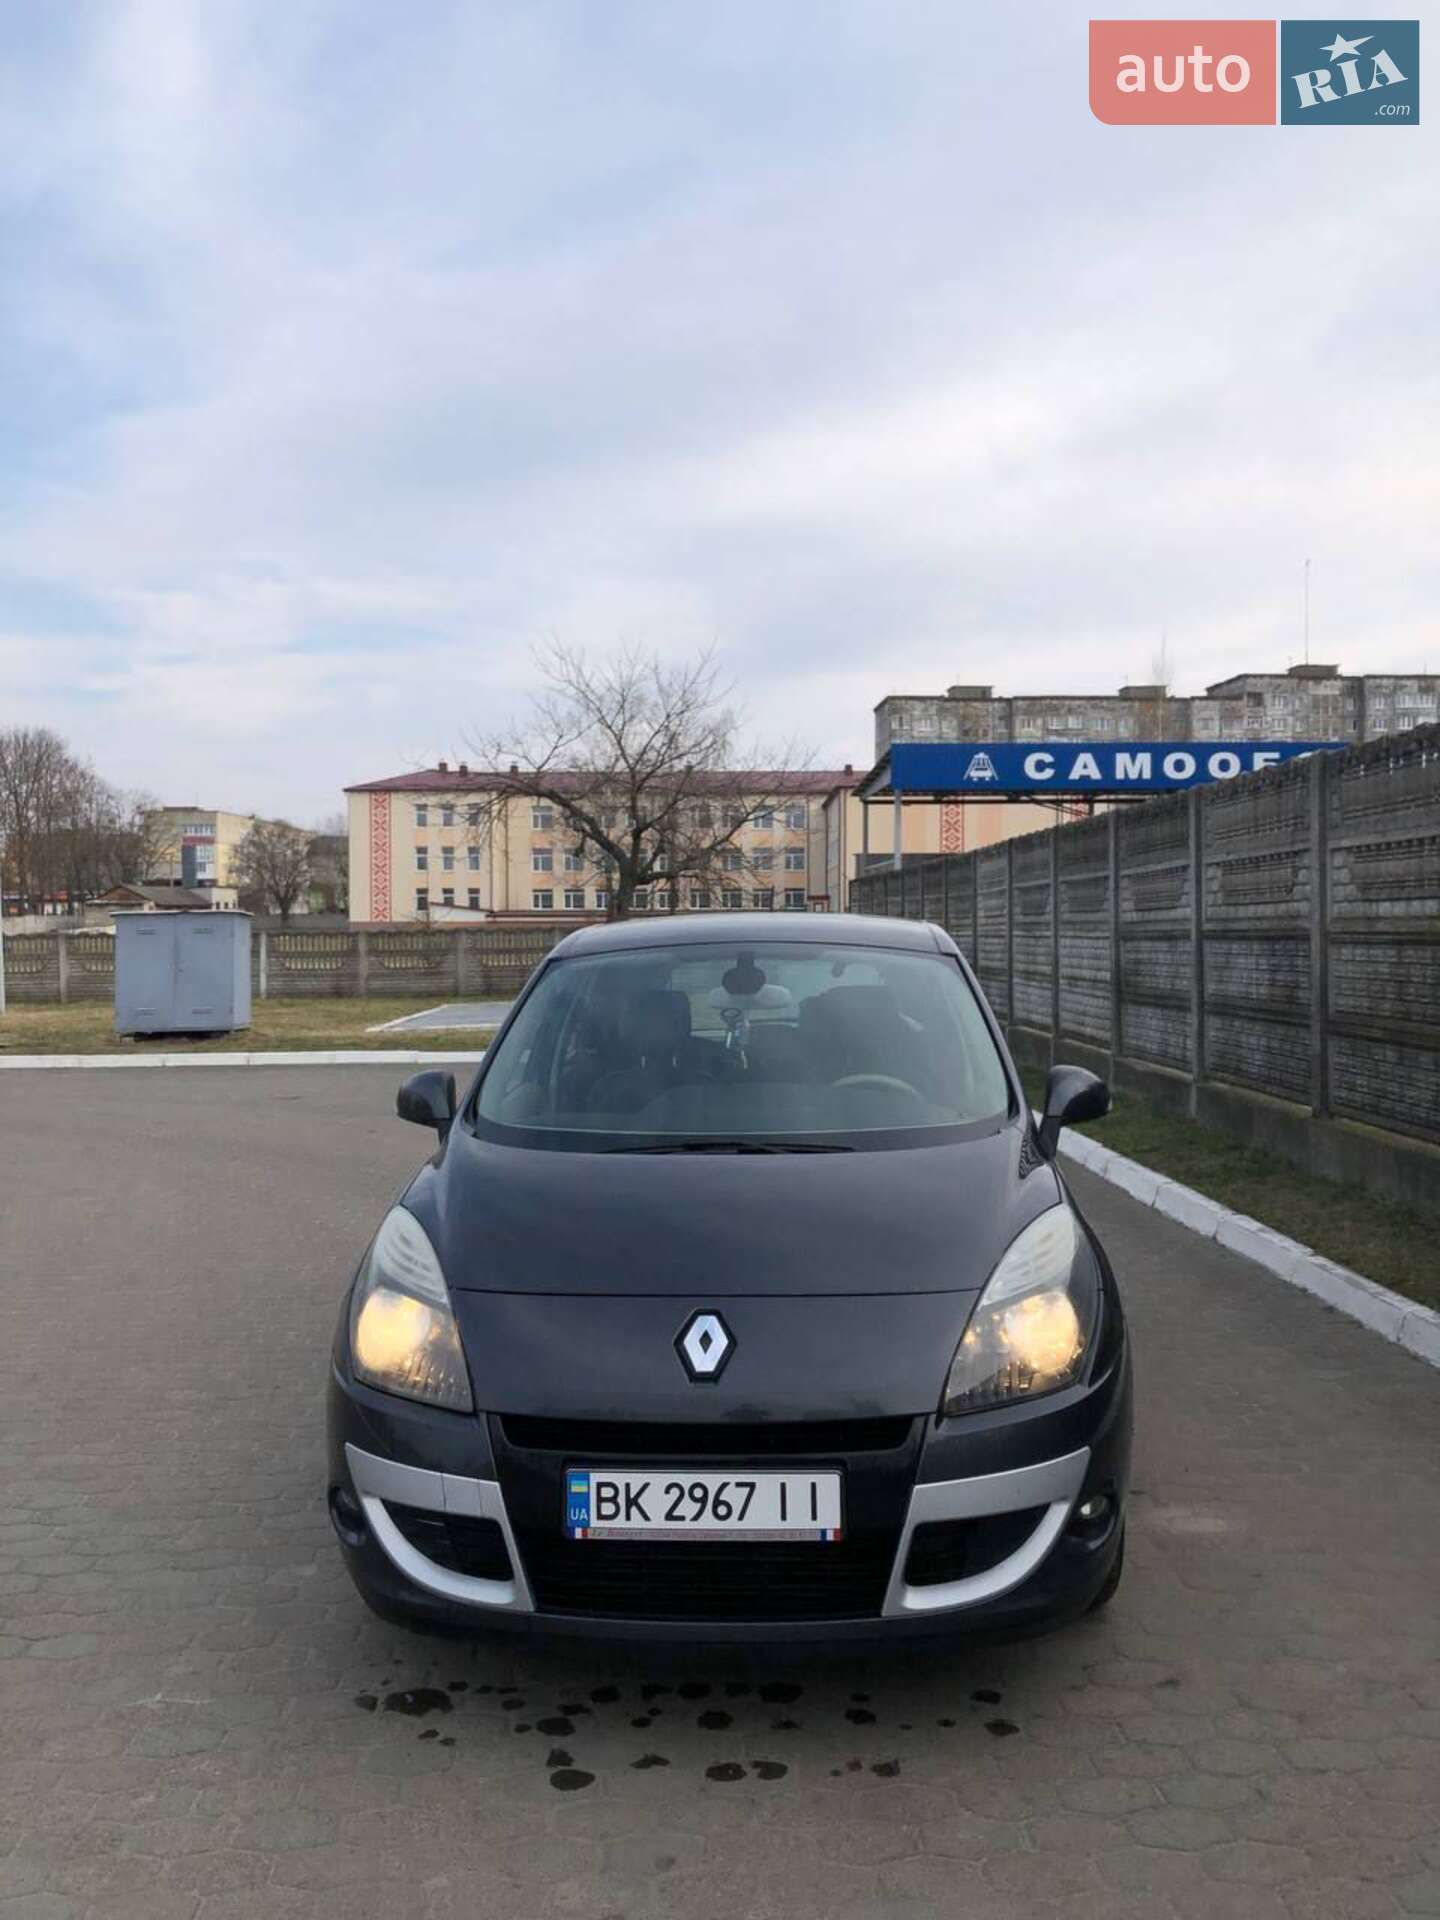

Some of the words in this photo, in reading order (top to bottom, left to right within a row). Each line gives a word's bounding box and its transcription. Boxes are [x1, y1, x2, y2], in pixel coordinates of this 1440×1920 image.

[1023, 751, 1313, 780] САМООБ
[570, 1509, 588, 1521] UA
[595, 1481, 651, 1522] BK
[664, 1481, 757, 1522] 2967
[779, 1481, 818, 1522] II
